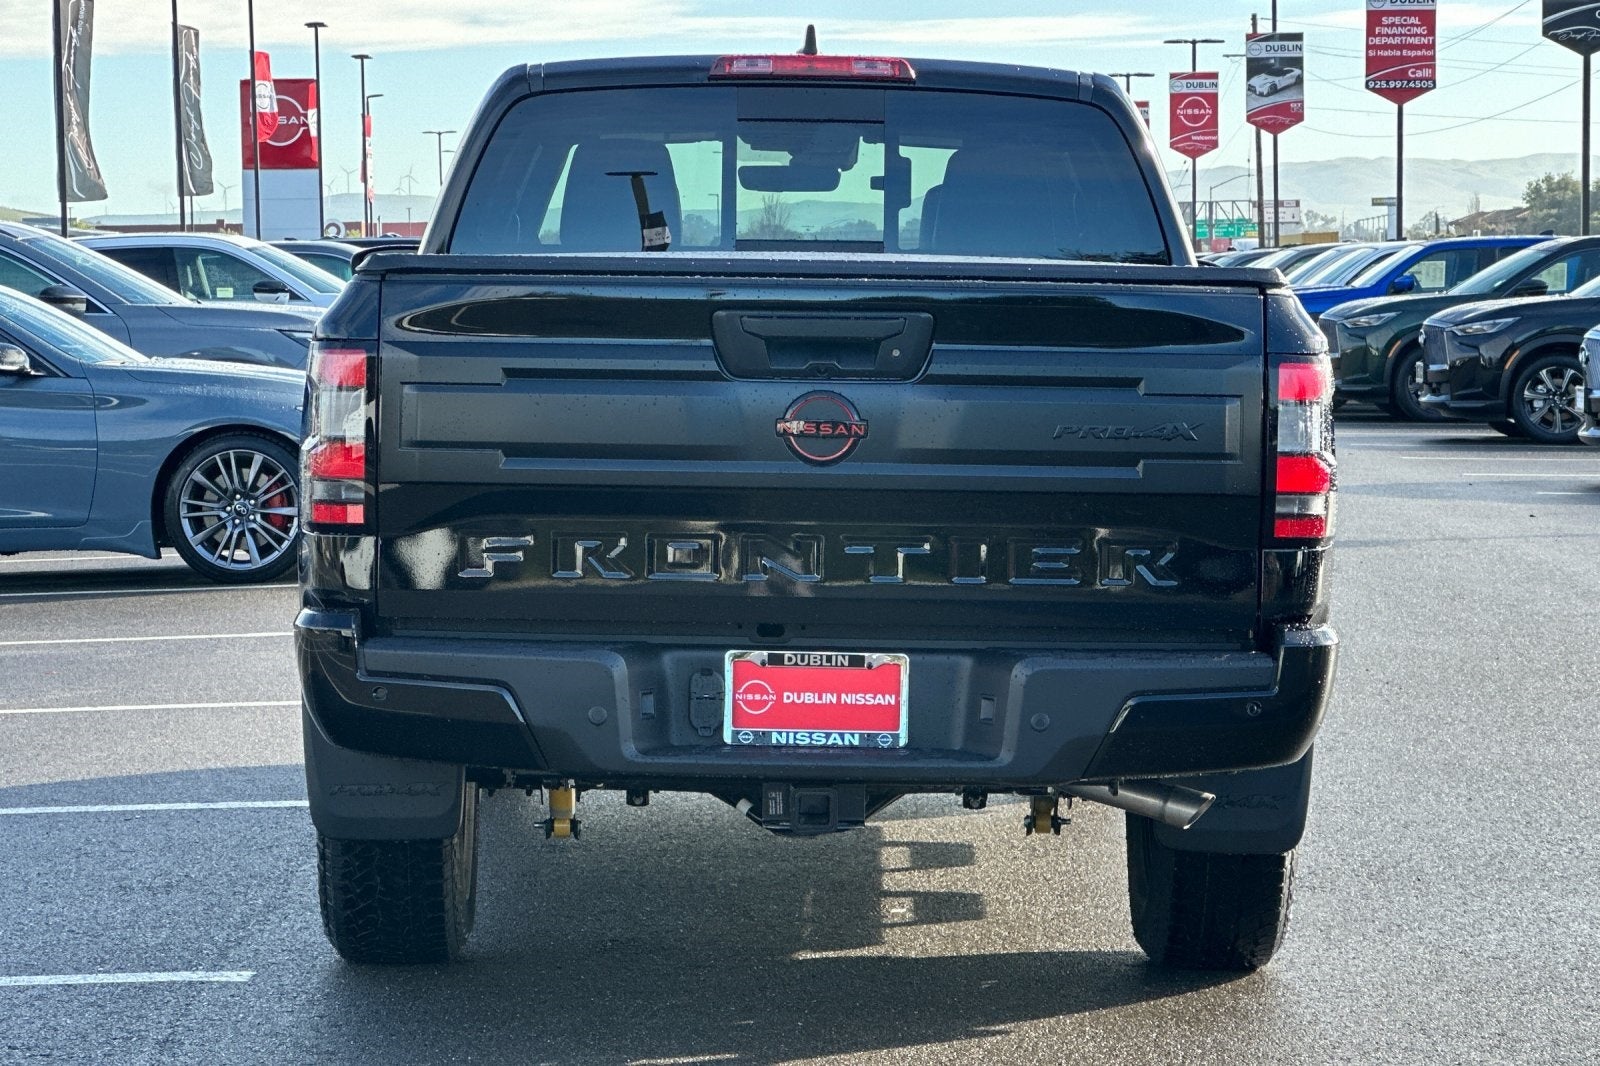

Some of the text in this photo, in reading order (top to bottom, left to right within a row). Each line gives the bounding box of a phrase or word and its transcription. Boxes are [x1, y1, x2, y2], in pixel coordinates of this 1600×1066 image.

[1381, 16, 1421, 24] SPECIAL
[1375, 26, 1428, 35] FINANCING
[1368, 36, 1434, 44] DEPARTMENT
[1265, 44, 1302, 52] DUBLIN
[1402, 49, 1434, 58] Español
[1408, 68, 1432, 77] Call!
[1185, 81, 1218, 89] DUBLIN
[1368, 80, 1434, 88] 925.997.4505
[777, 420, 865, 435] NISSAN
[457, 534, 1181, 588] FRONTIER
[783, 653, 849, 667] DUBLIN
[735, 693, 777, 701] NISSAN
[782, 691, 895, 705] DUBLIN NISSAN
[771, 731, 860, 746] NISSAN
